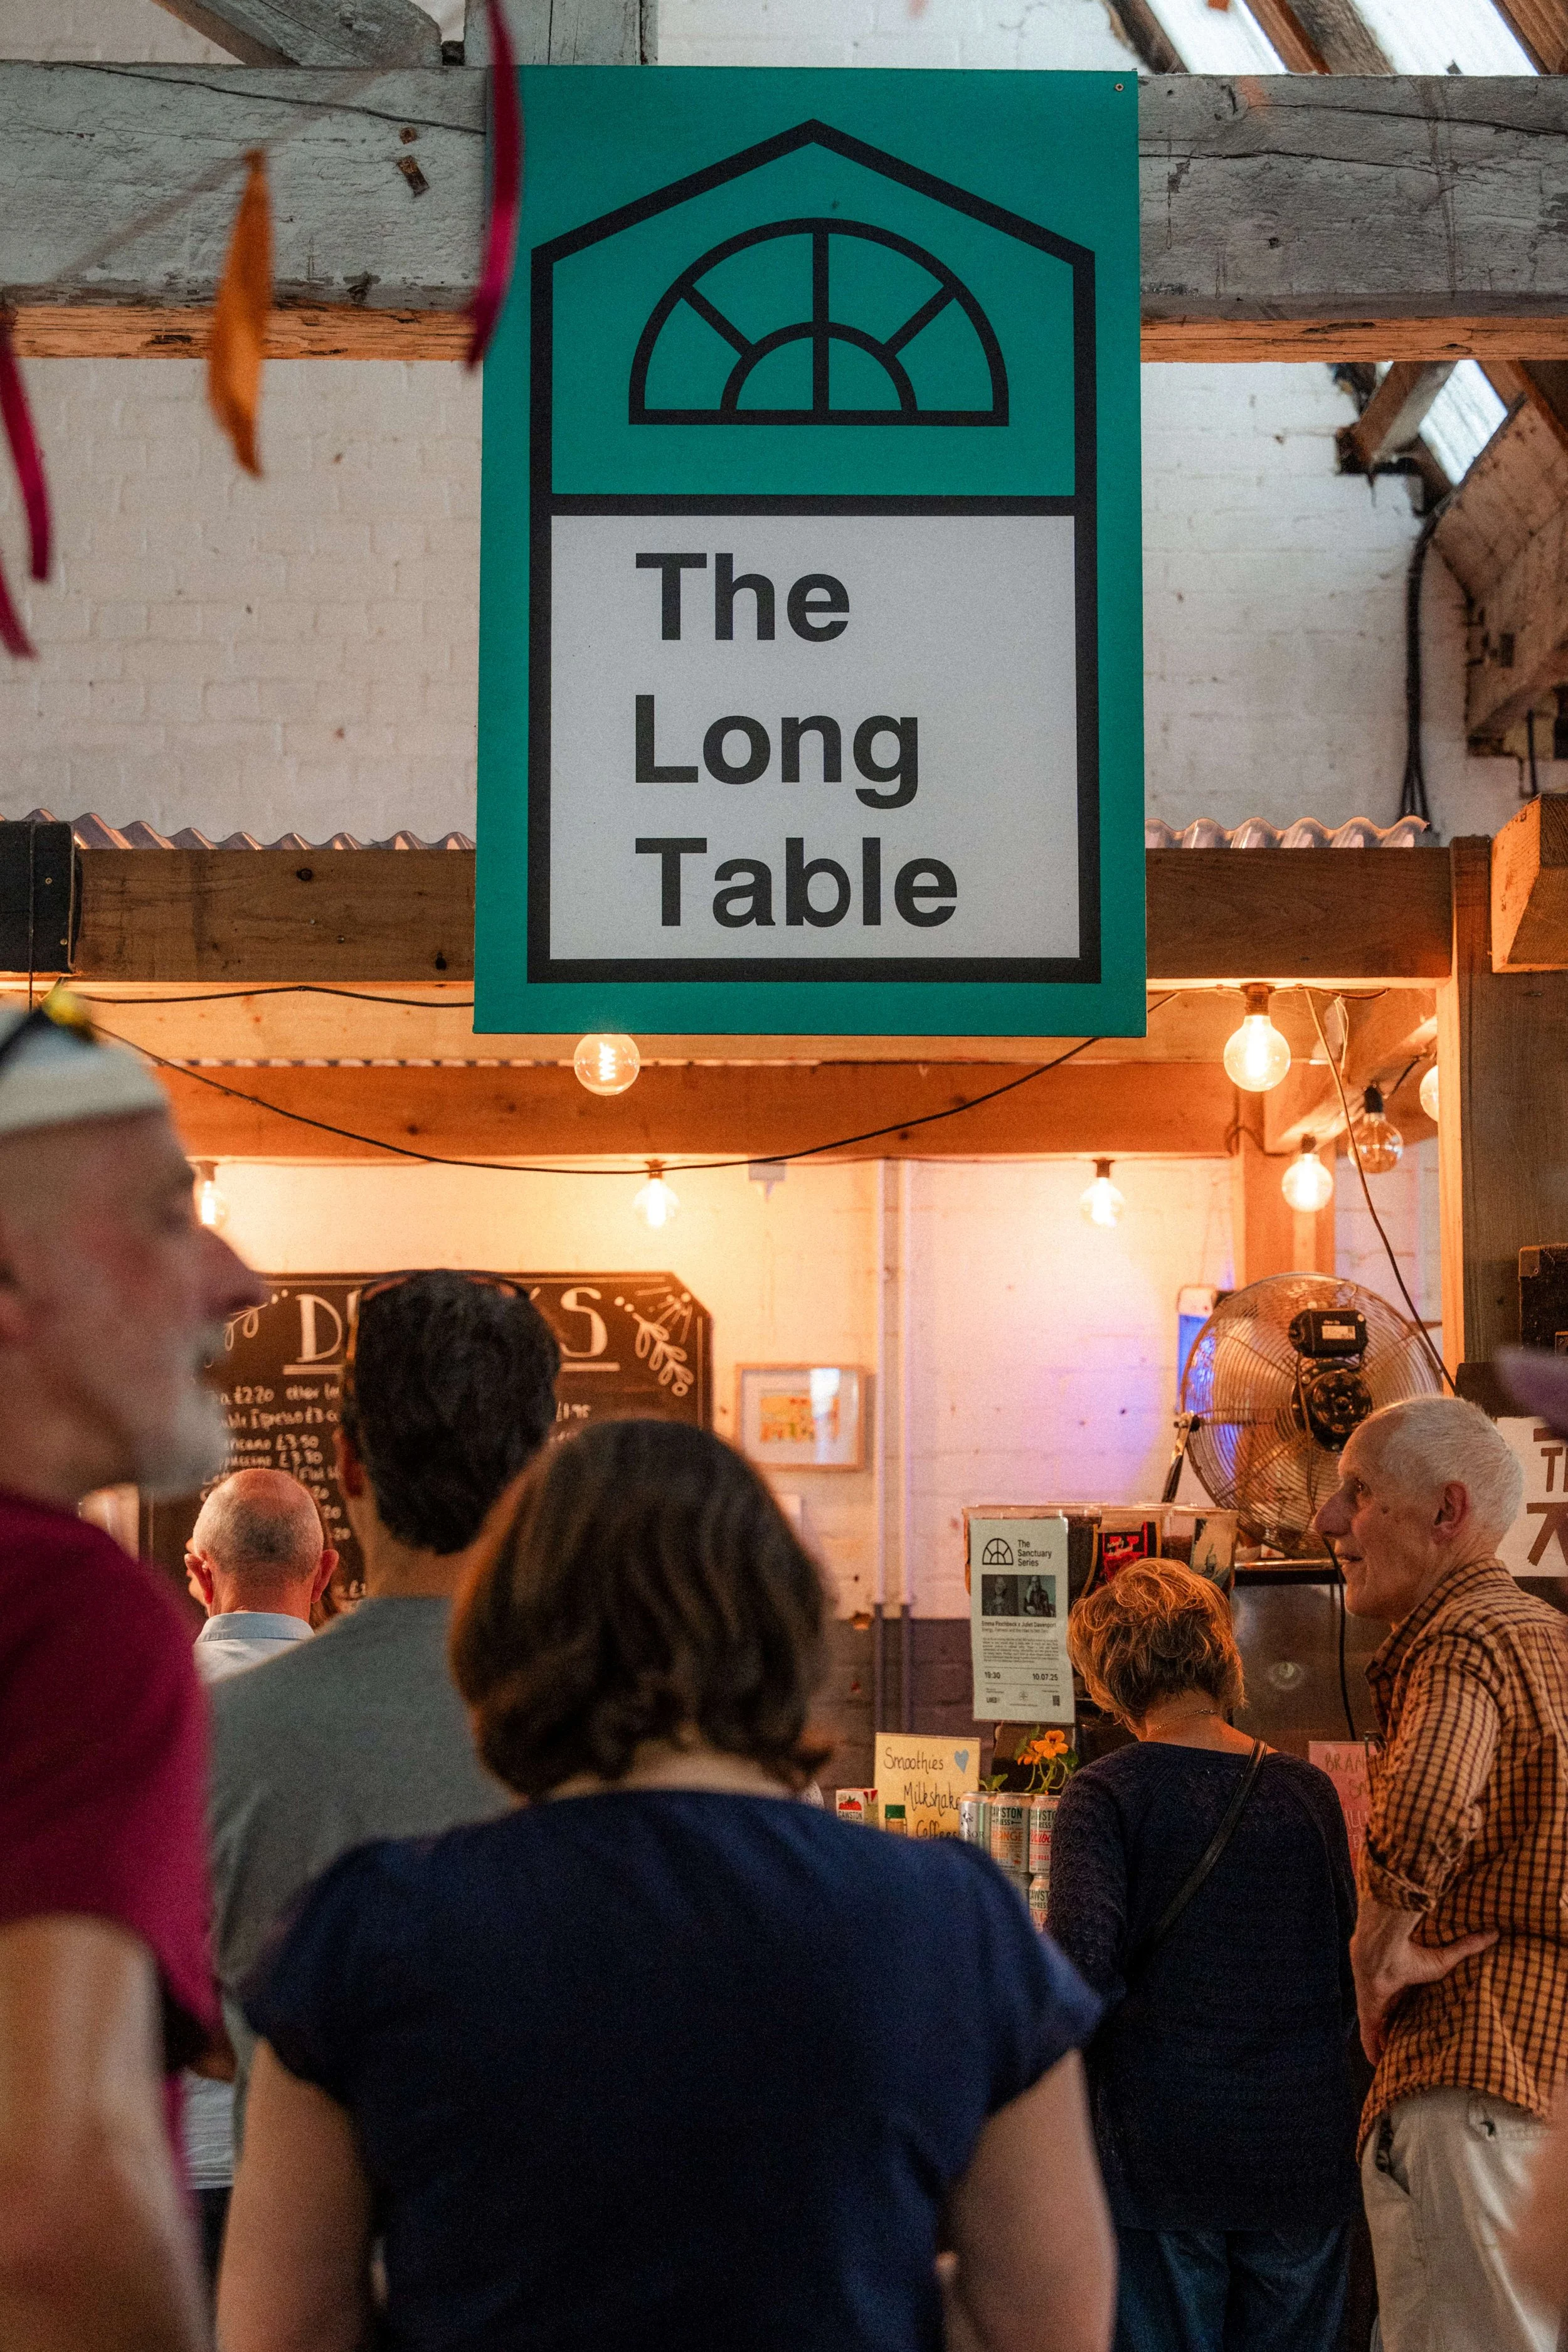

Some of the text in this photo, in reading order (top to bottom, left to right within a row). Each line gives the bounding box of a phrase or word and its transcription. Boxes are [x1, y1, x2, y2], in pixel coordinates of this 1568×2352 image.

[635, 553, 850, 642] The
[635, 694, 919, 810] Long
[635, 837, 958, 928] Table
[1018, 1540, 1030, 1548] The
[1017, 1549, 1052, 1559] Sanctuary
[1018, 1558, 1039, 1567] Series
[1032, 1673, 1059, 1681] 10.07.25
[884, 1747, 943, 1774] Smoothies
